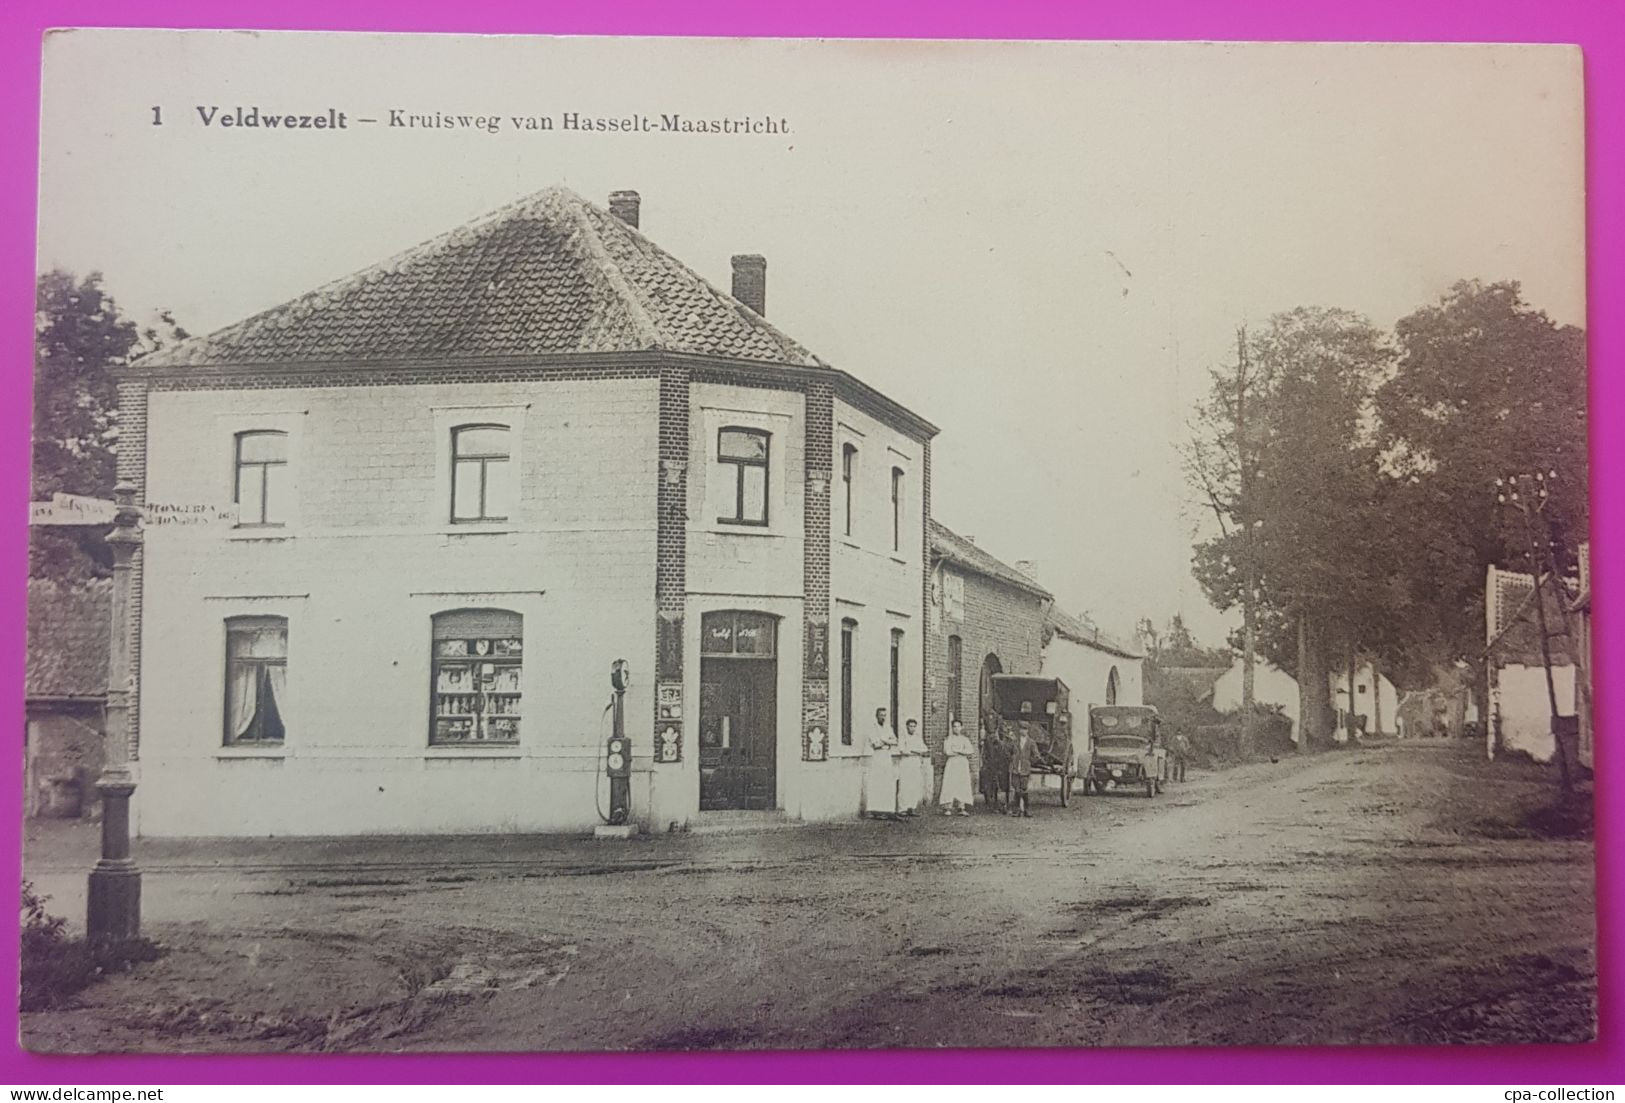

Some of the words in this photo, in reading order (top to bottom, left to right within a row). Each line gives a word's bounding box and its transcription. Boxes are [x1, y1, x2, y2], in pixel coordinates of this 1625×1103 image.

[151, 106, 162, 125] 1
[197, 106, 347, 129] Veldwezelt
[389, 109, 501, 133] Kruisweg
[511, 116, 554, 131] van
